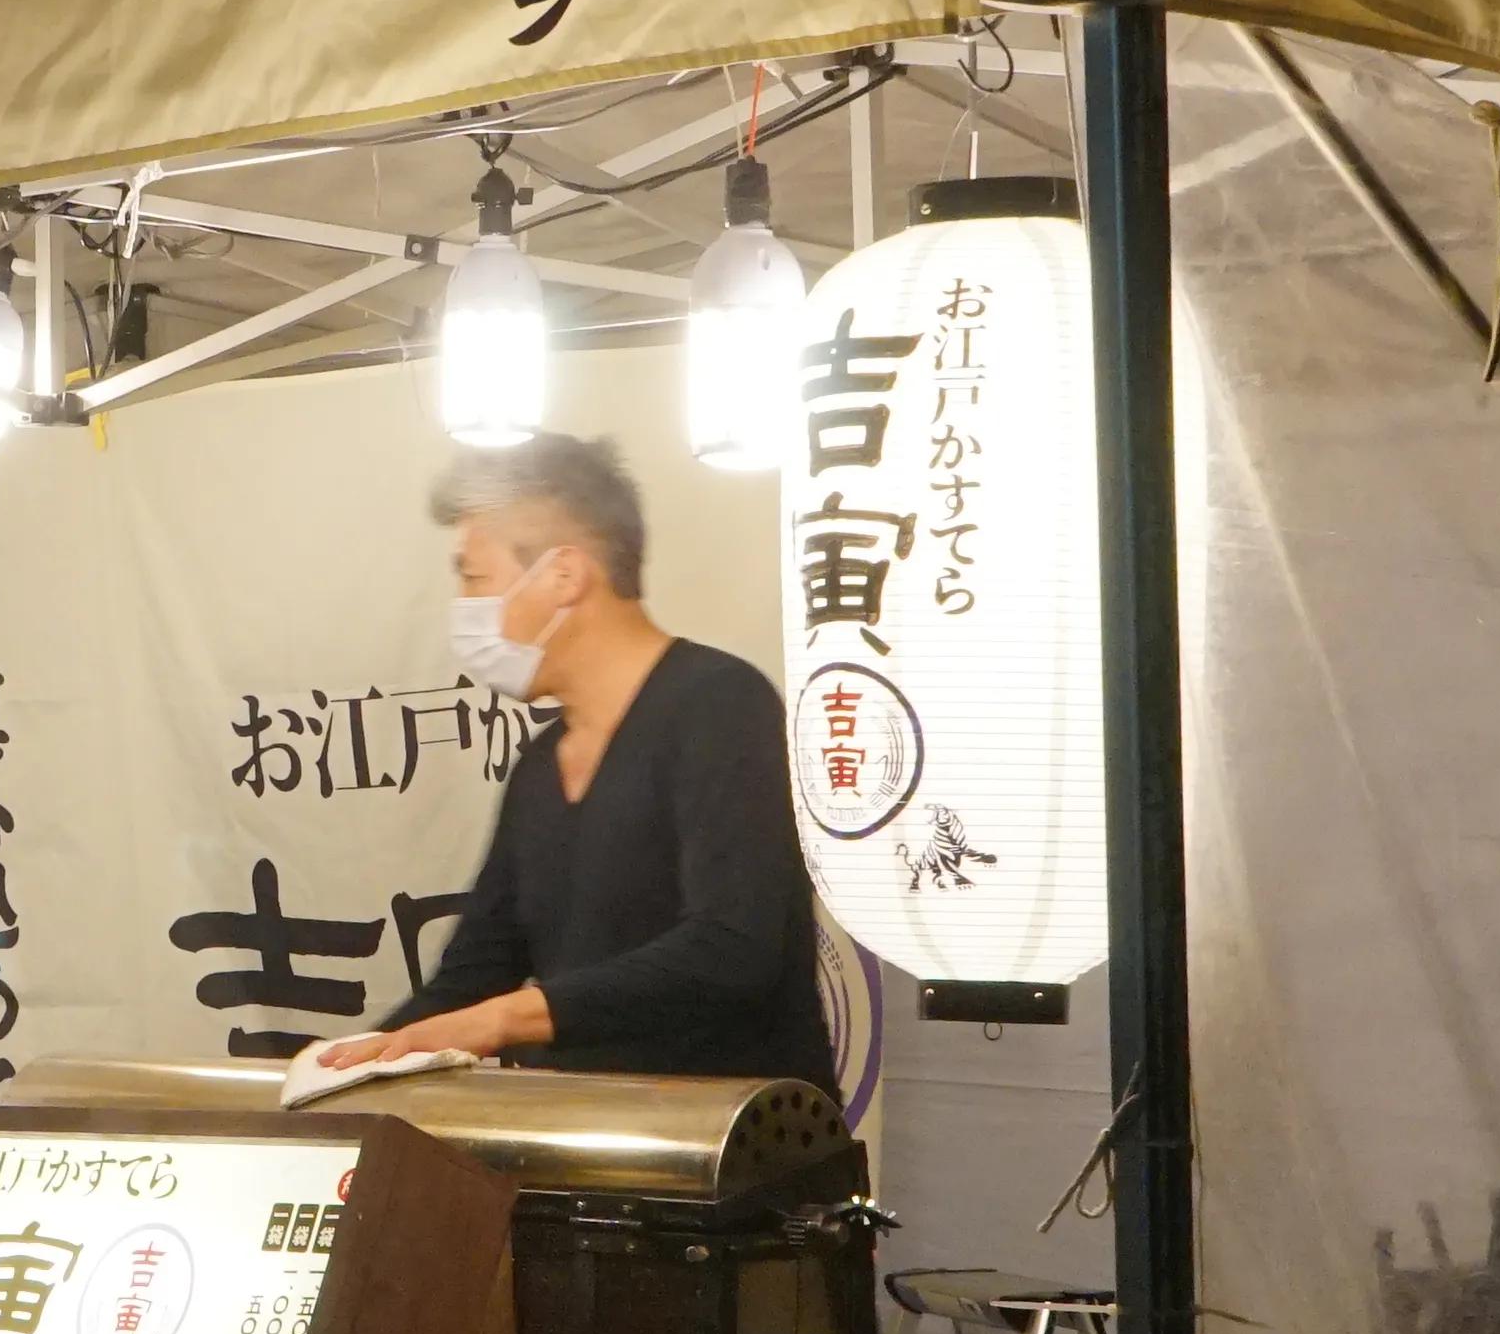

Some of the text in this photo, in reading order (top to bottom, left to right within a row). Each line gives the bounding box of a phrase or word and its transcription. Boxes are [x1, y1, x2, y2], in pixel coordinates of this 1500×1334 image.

[793, 307, 925, 658] 吉寅
[928, 276, 994, 616] お江戸かすてら
[230, 672, 560, 798] お江戸か
[821, 682, 865, 799] 吉寅
